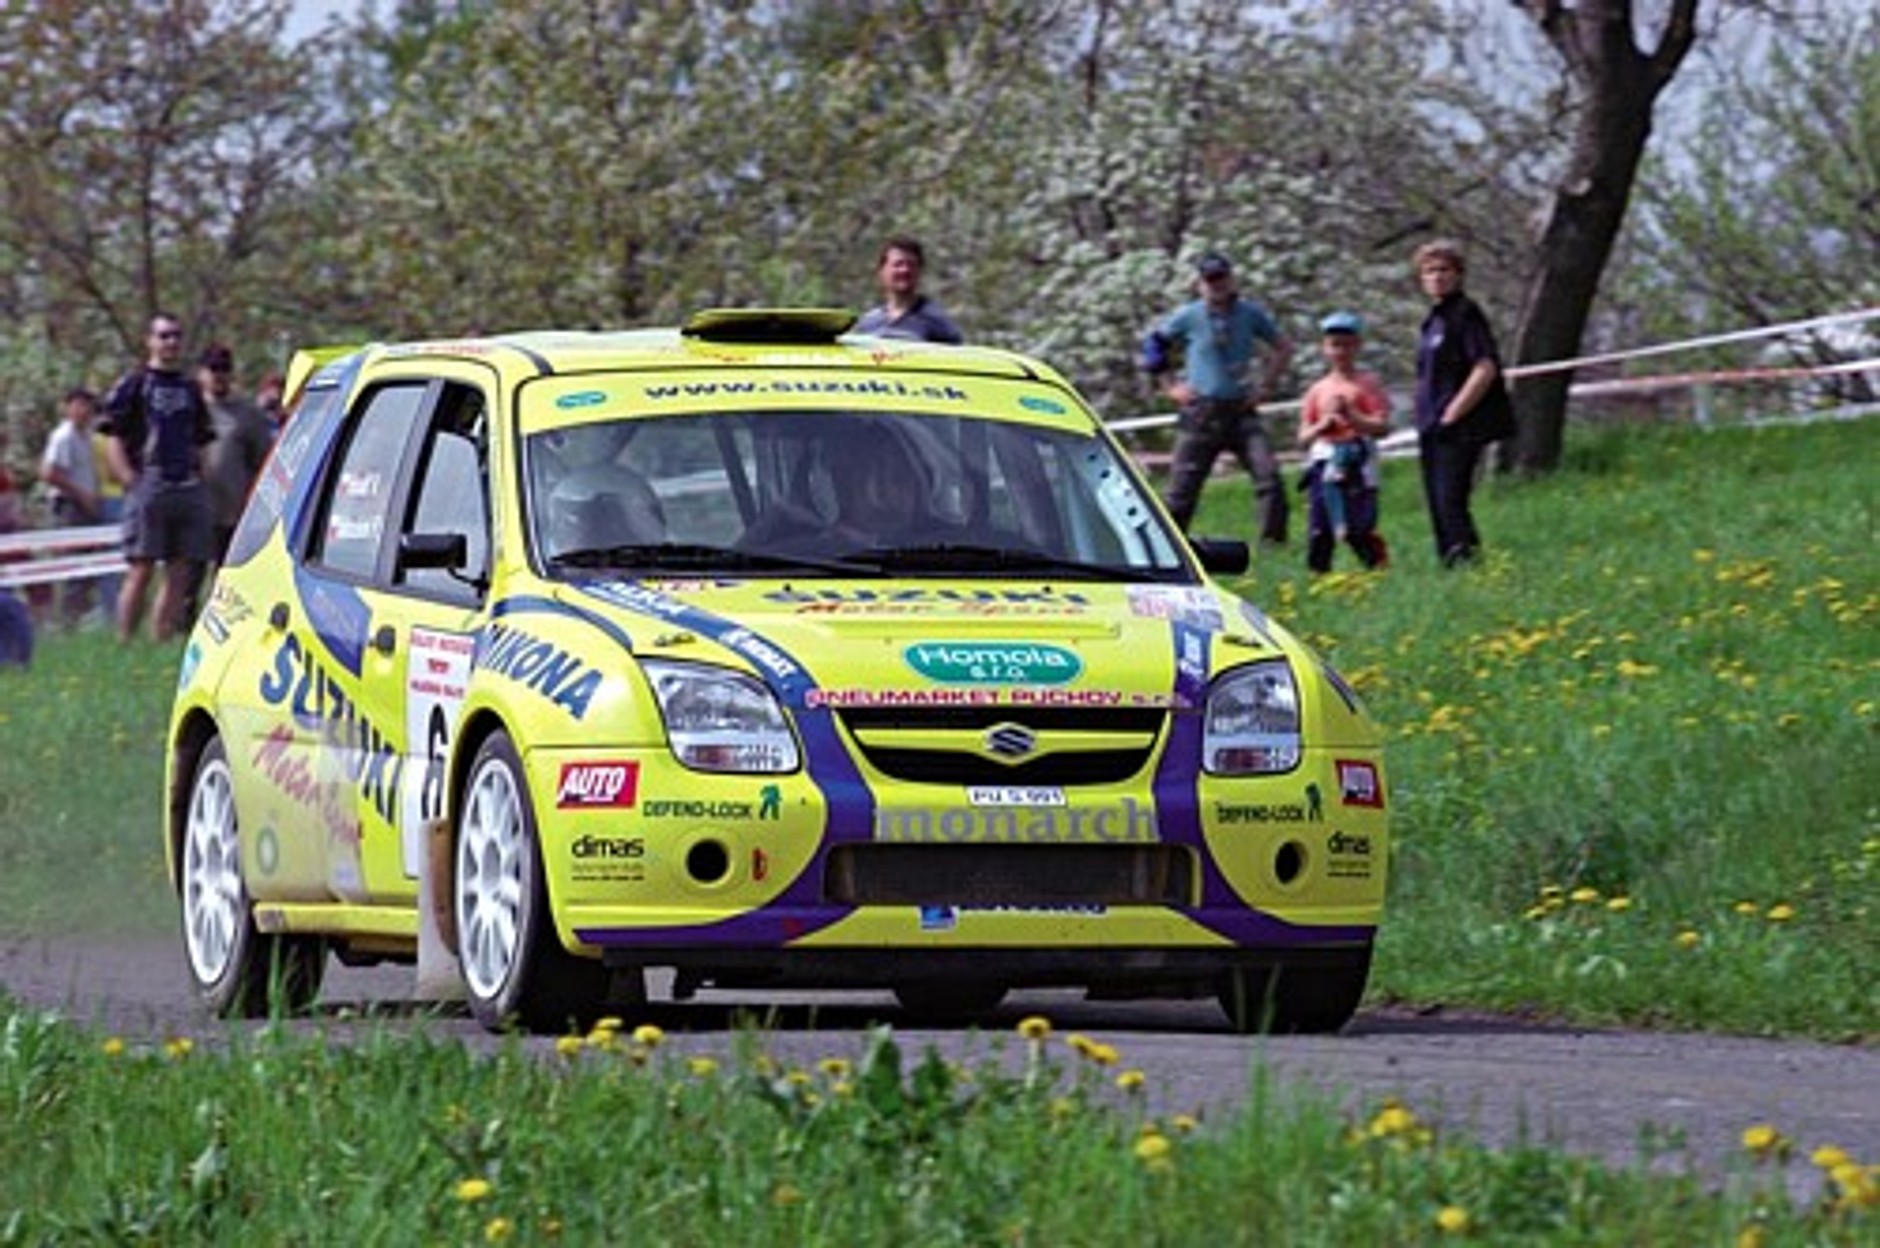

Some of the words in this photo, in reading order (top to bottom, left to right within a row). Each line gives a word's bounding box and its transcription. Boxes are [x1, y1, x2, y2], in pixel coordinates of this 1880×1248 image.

[644, 379, 969, 402] www.suzuki.sk
[916, 643, 1070, 667] Homola
[260, 631, 402, 825] SUZUKI
[421, 702, 449, 821] 6
[559, 765, 626, 798] AUTO
[643, 800, 753, 818] DEFEND-LOCK
[873, 797, 1162, 842] monarch
[571, 834, 645, 858] dimas
